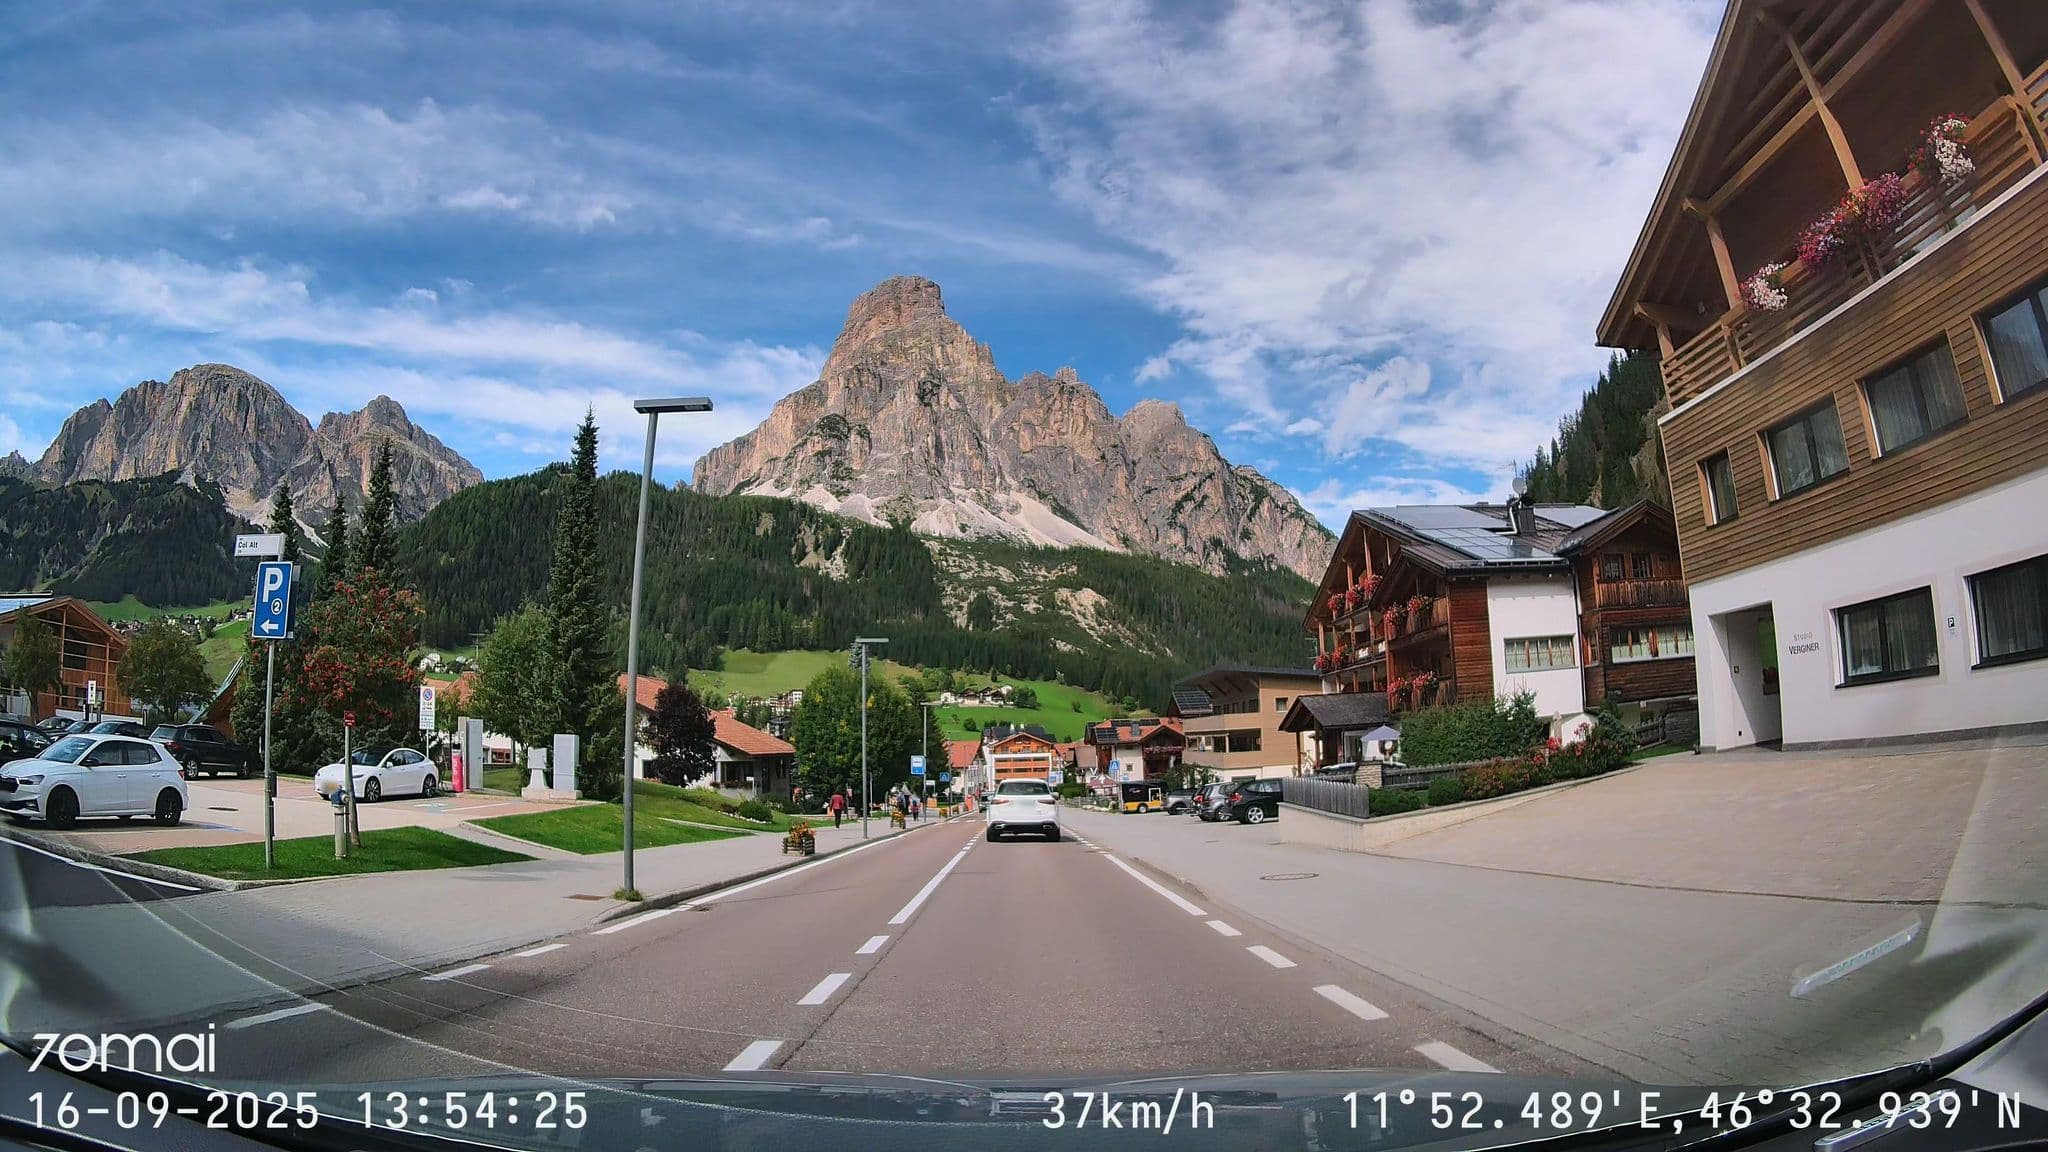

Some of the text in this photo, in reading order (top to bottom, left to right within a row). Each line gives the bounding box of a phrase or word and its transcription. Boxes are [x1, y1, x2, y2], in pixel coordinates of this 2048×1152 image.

[238, 541, 258, 549] Col Alt
[262, 567, 283, 603] P
[1788, 642, 1820, 655] VERGINER
